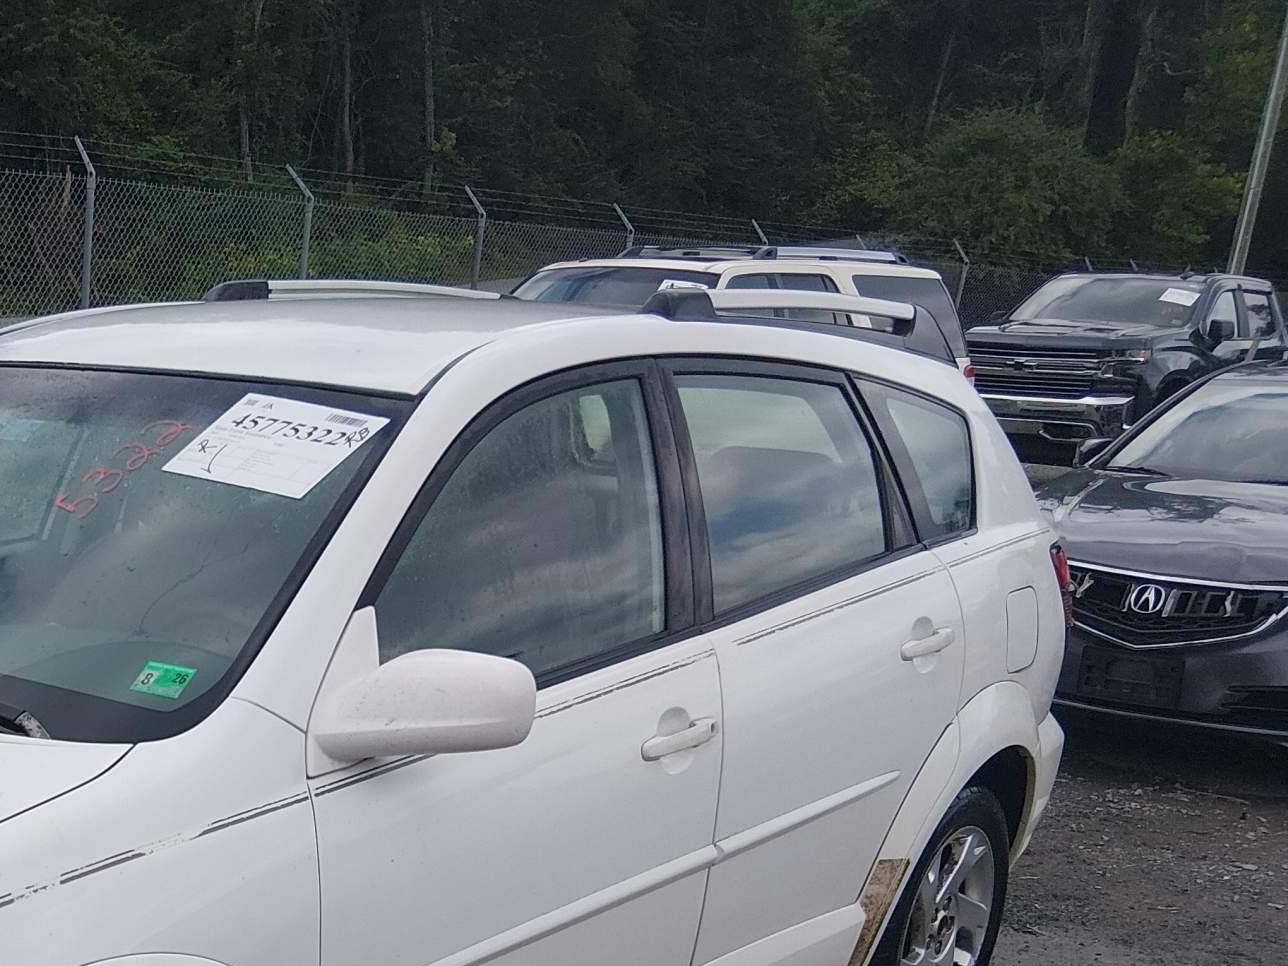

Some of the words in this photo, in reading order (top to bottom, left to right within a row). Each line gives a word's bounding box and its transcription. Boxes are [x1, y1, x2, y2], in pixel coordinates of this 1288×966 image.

[232, 413, 347, 446] 45775322
[55, 419, 195, 520] 5322
[140, 672, 154, 685] 8
[172, 672, 189, 685] 26
